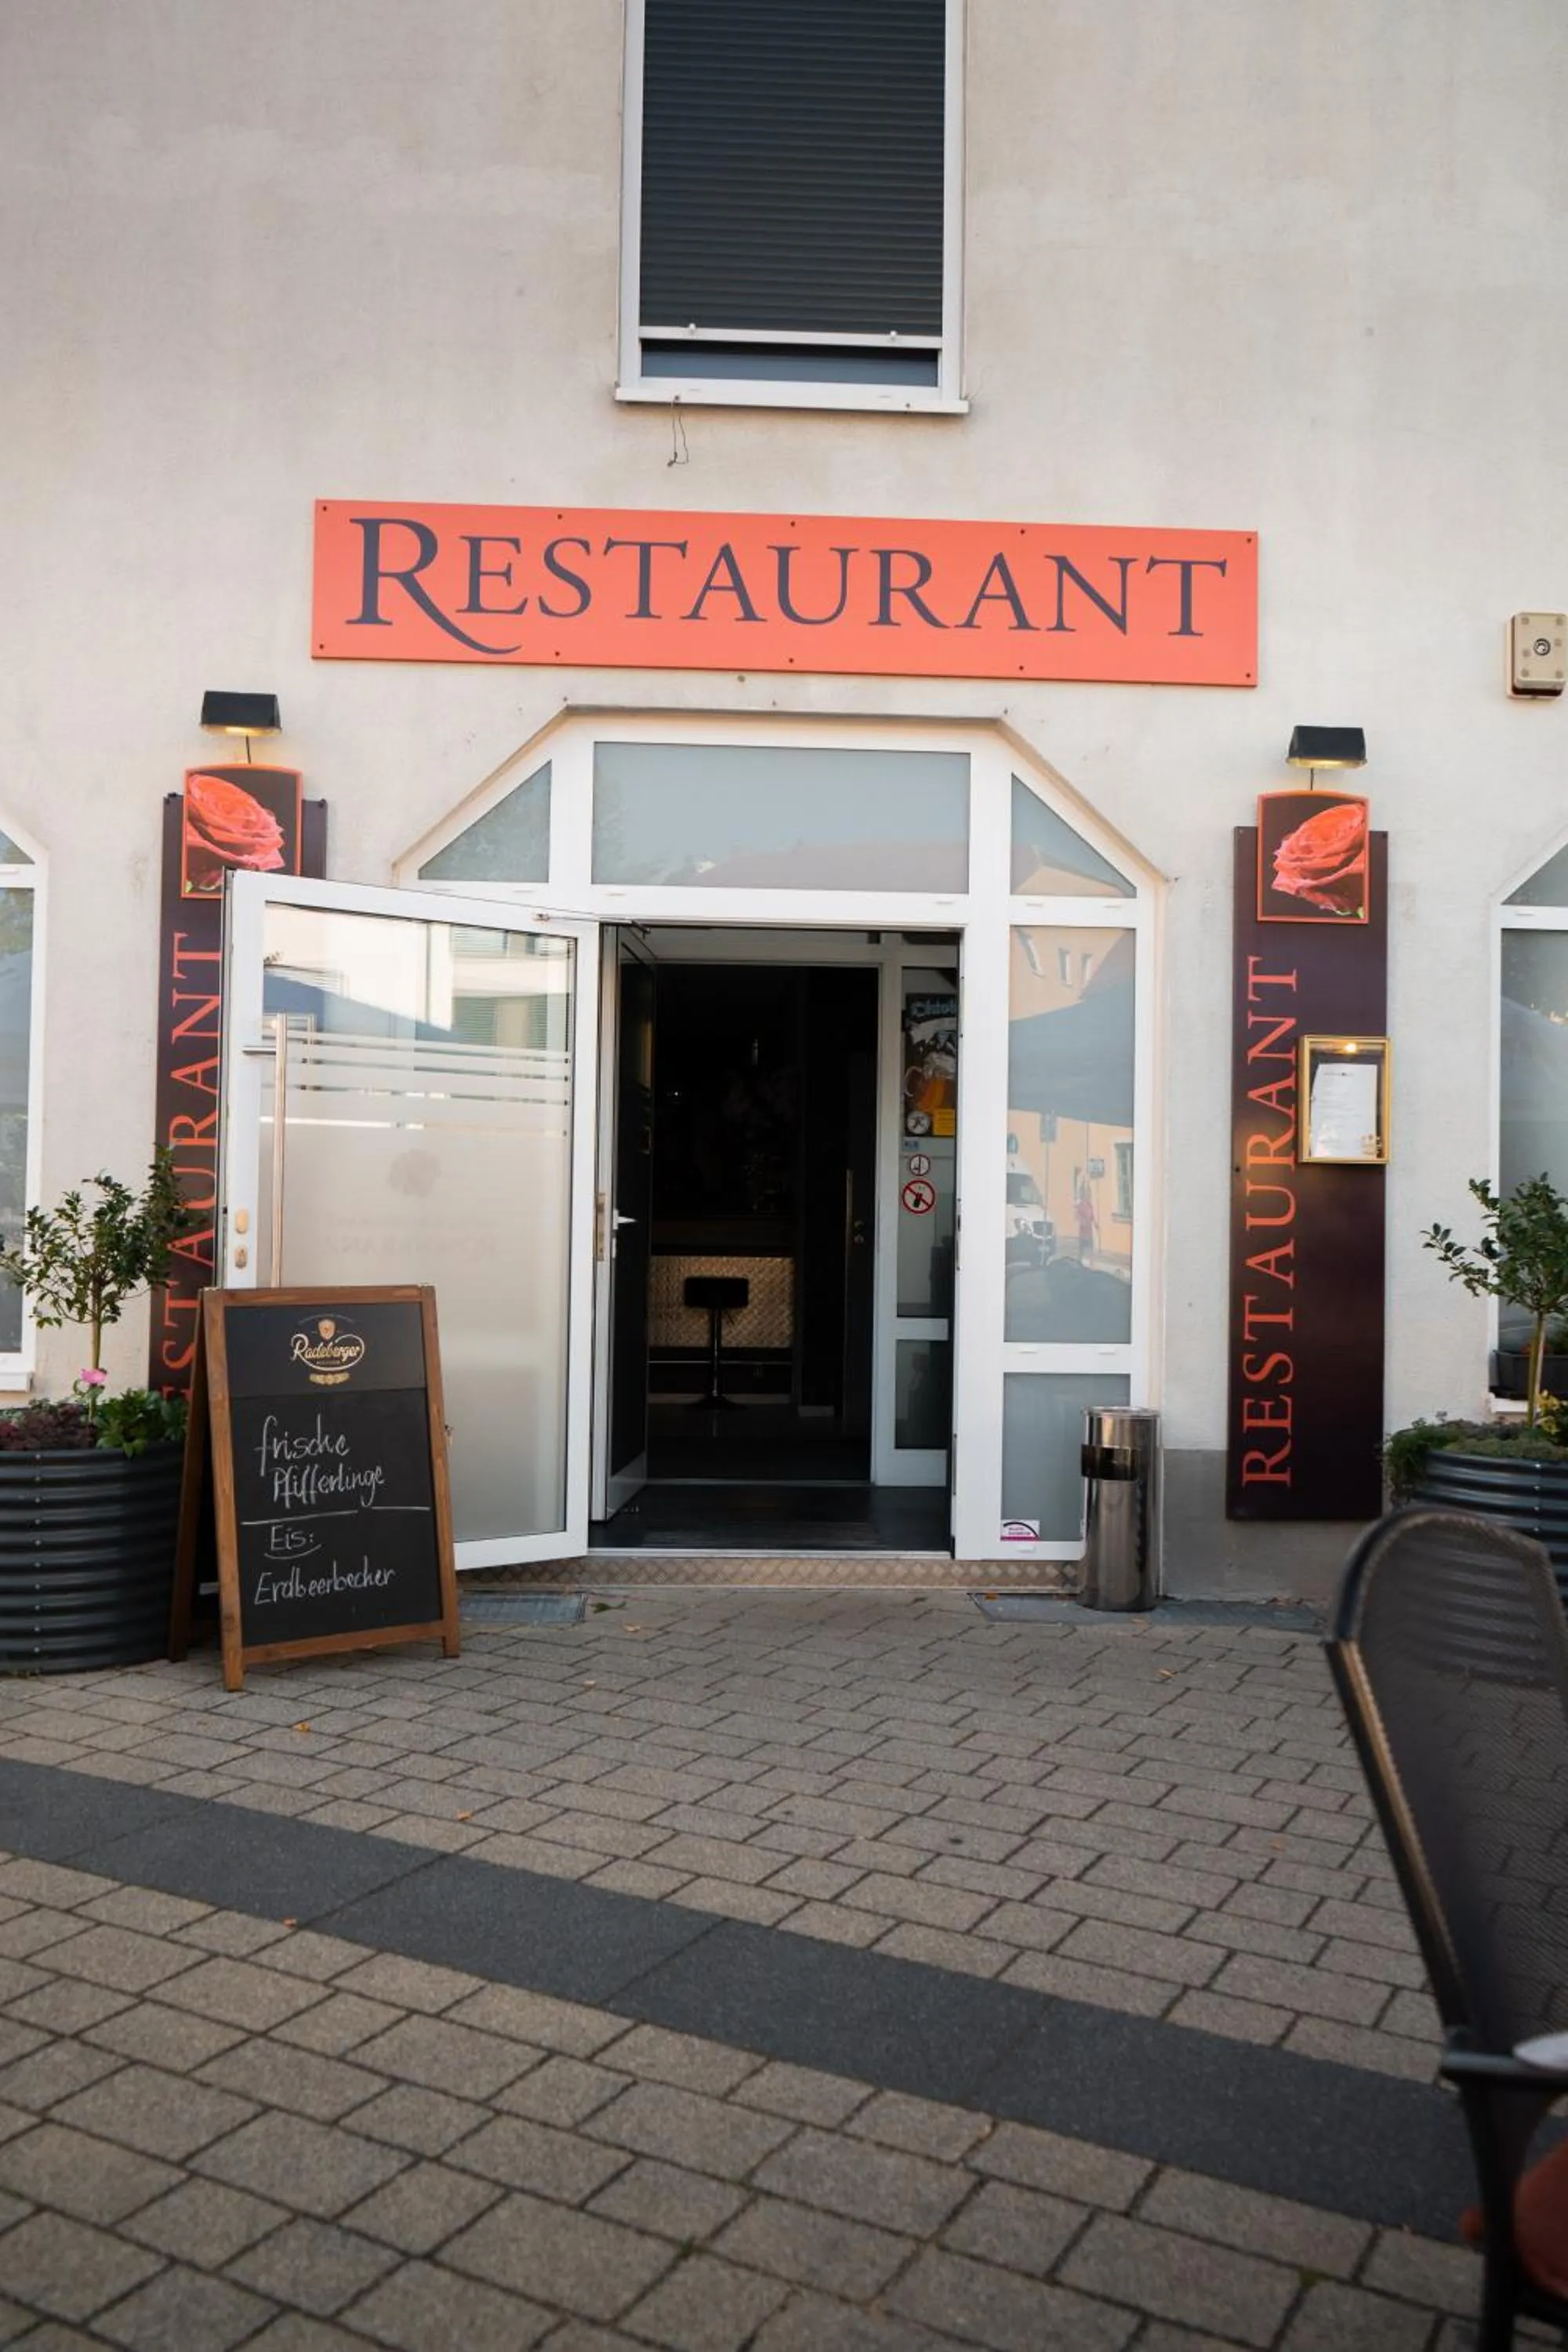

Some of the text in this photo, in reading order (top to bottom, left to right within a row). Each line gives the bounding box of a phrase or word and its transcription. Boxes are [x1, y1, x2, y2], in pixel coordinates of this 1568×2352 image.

[345, 517, 1228, 655] RESTAURANT
[162, 931, 221, 1402] STAURANT
[1242, 955, 1298, 1487] RESTAURANT
[290, 1333, 365, 1366] Radeberger
[254, 1414, 351, 1477] frische
[272, 1462, 386, 1509] Pfifferlinge
[270, 1526, 314, 1550] Eis:
[255, 1555, 395, 1605] Erdbeerbecher
